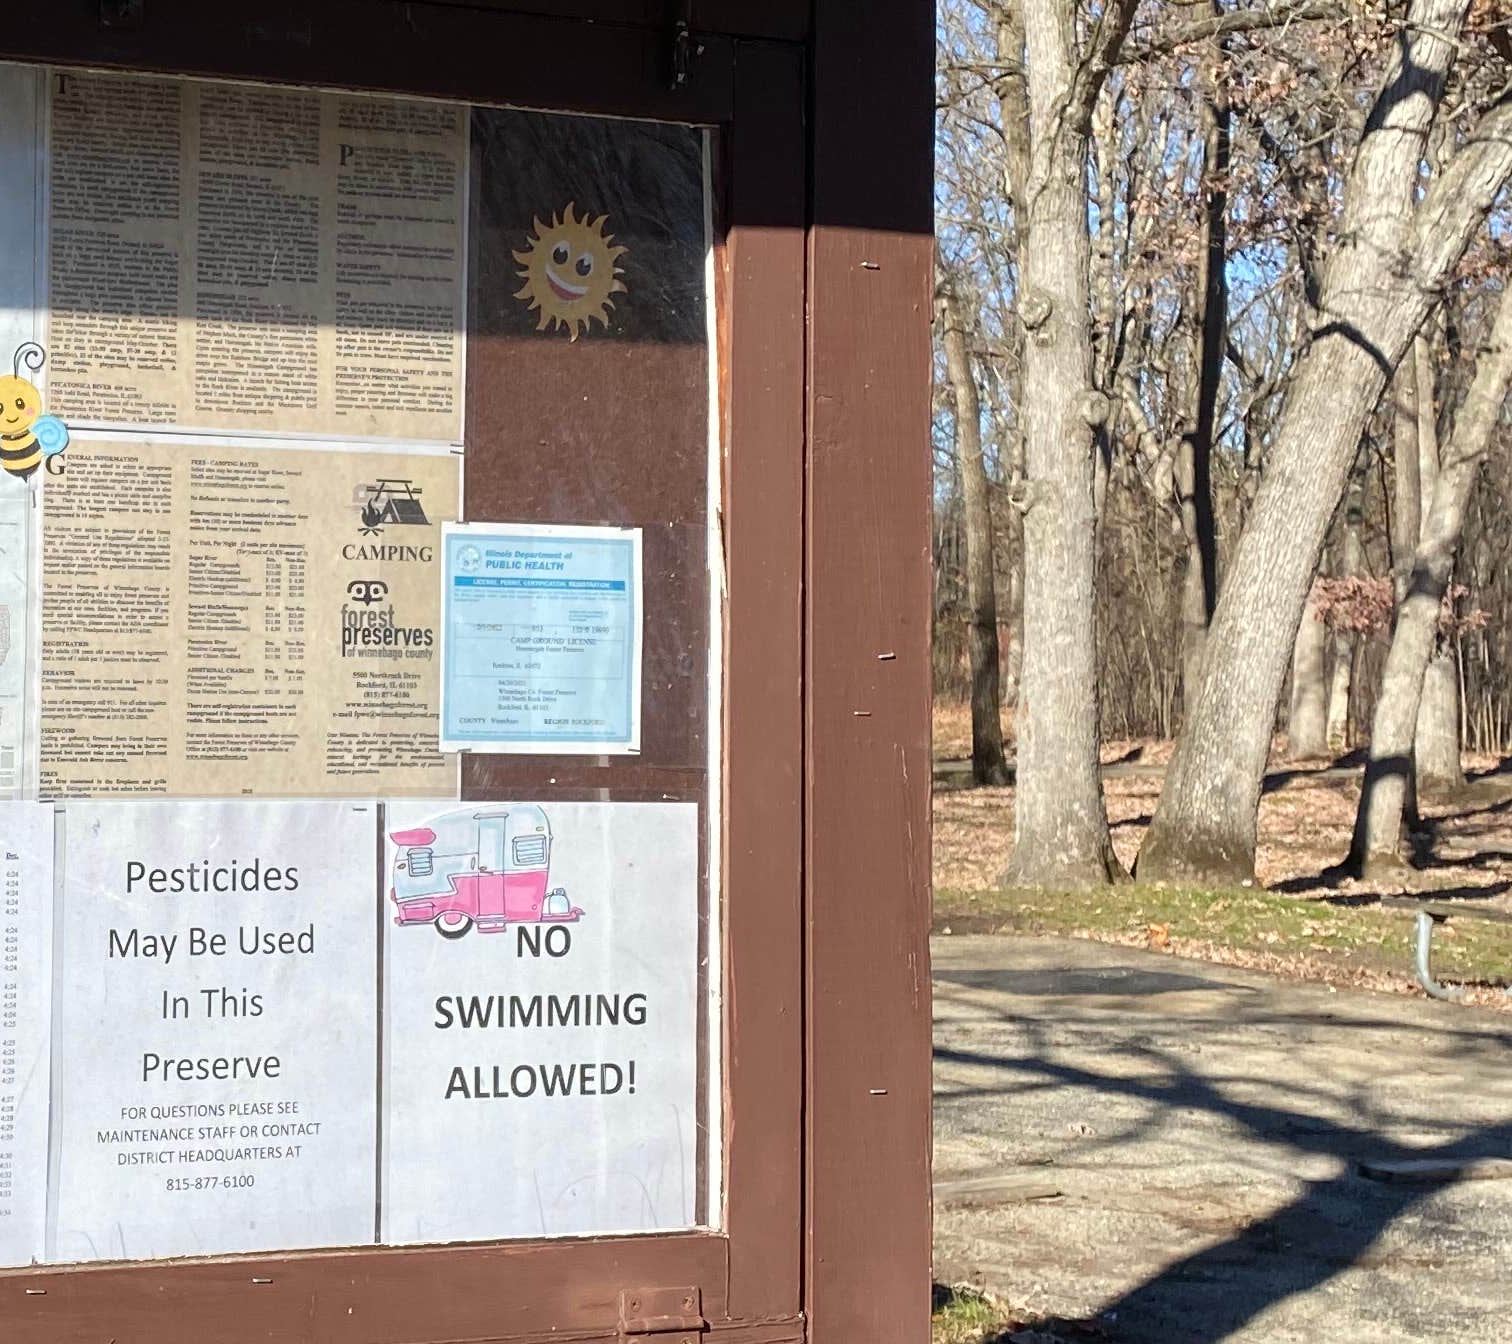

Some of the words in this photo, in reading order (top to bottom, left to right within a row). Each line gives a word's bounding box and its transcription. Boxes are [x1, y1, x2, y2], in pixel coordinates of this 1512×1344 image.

[343, 544, 432, 562] CAMPING
[486, 550, 512, 558] Illinois
[515, 550, 562, 560] Department
[486, 560, 522, 569] PUBLIC
[525, 561, 564, 570] HEALTH
[341, 604, 394, 628] forest
[342, 627, 433, 657] preserves
[533, 637, 564, 645] GROUND
[347, 647, 356, 658] of
[358, 647, 402, 660] winnebago
[405, 647, 433, 660] county
[356, 681, 388, 689] Rockford,
[126, 858, 299, 894] Pesticides
[108, 928, 179, 964] May
[189, 927, 228, 958] Be
[238, 923, 315, 957] Used
[516, 925, 572, 958] NO
[162, 990, 189, 1019] In
[200, 987, 264, 1018] This
[434, 992, 648, 1029] SWIMMING
[142, 1051, 281, 1082] Preserve
[444, 1063, 638, 1100] ALLOWED!
[120, 1103, 147, 1121] FOR
[149, 1102, 226, 1121] QUESTIONS
[228, 1101, 275, 1117] PLEASE
[277, 1100, 299, 1115] SEE
[97, 1126, 195, 1145] MAINTENANCE
[197, 1124, 237, 1141] STAFF
[239, 1123, 259, 1139] OR
[262, 1121, 322, 1138] CONTACT
[117, 1147, 177, 1165] DISTRICT
[178, 1146, 283, 1164] HEADQUARTERS
[285, 1145, 303, 1160] AT
[165, 1174, 255, 1191] 815-877-6100
